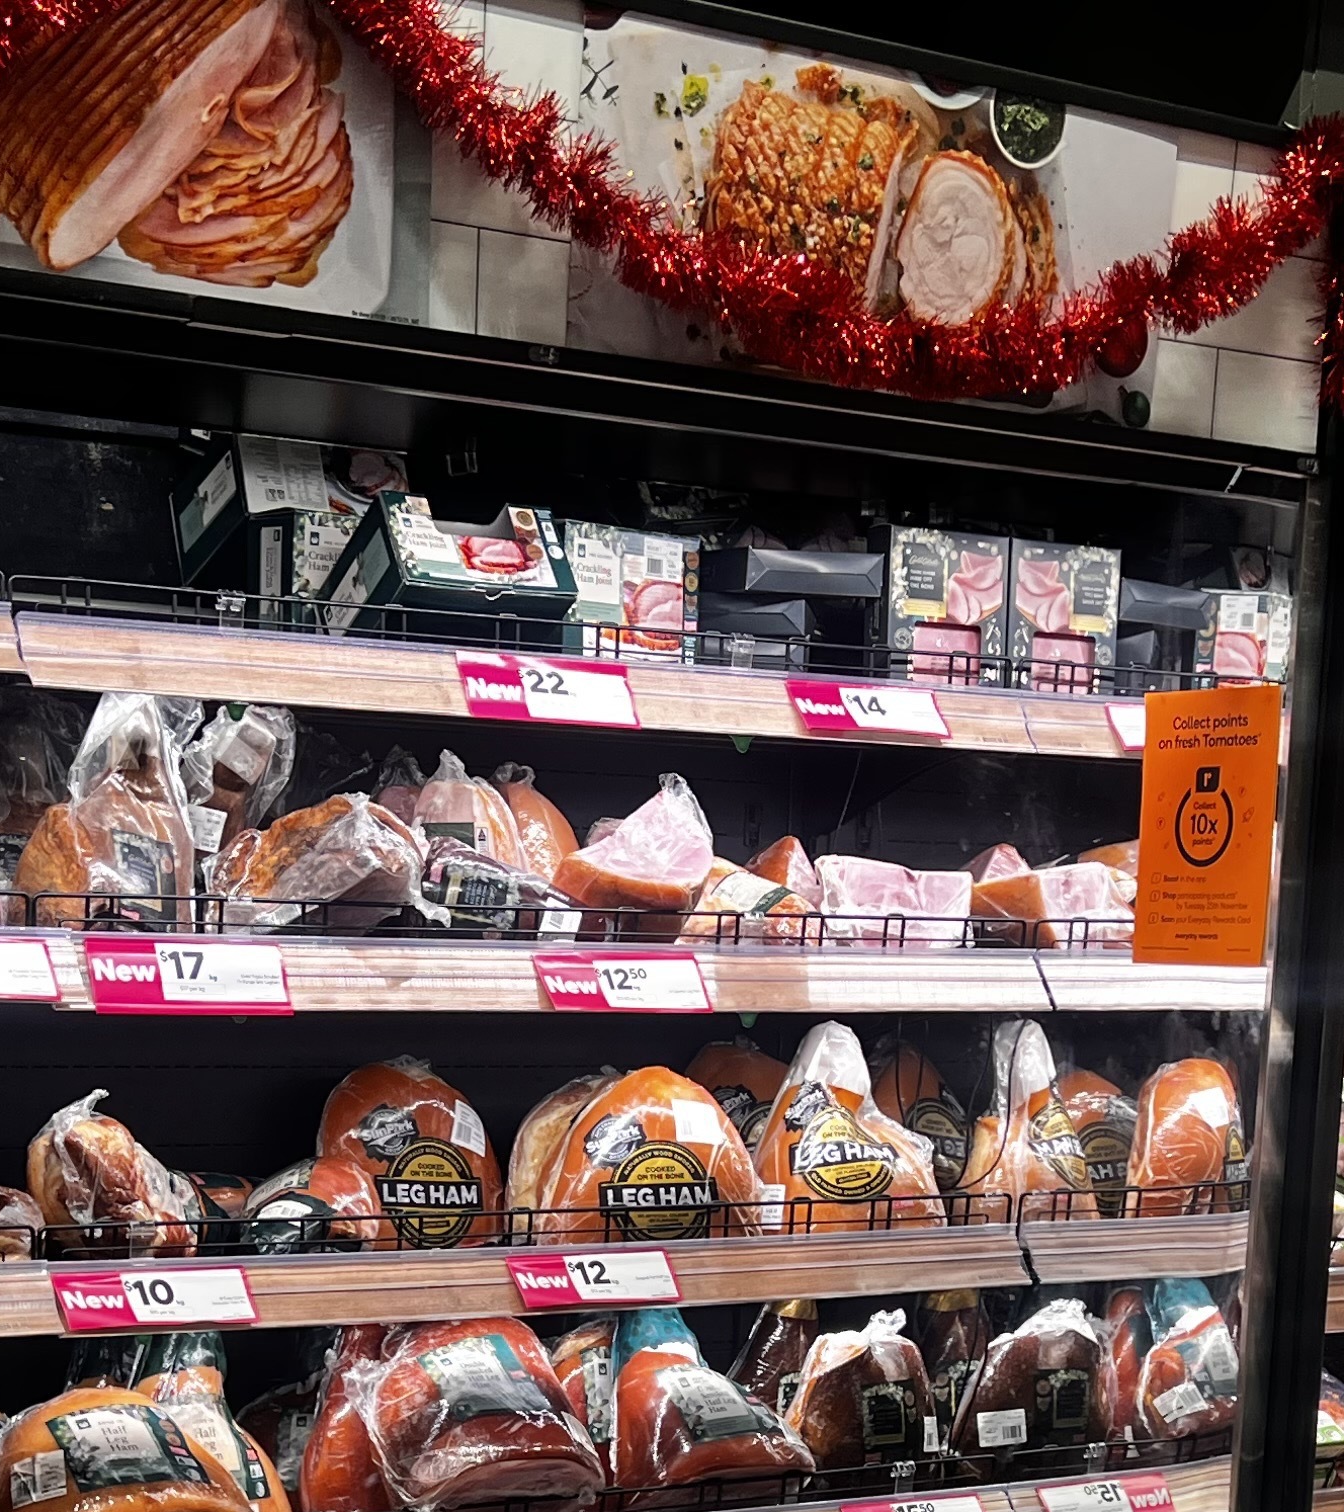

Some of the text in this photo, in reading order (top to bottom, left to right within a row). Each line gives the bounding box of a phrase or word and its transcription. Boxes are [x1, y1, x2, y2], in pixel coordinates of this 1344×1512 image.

[308, 562, 330, 571] Ham
[577, 563, 612, 577] Crackling
[466, 676, 521, 701] New
[517, 669, 569, 695] $22
[795, 697, 846, 716] New
[1173, 713, 1249, 732] Collect points
[1158, 734, 1200, 749] on fresh
[1193, 801, 1216, 810] Collect
[1190, 813, 1218, 835] 10x
[91, 957, 156, 982] New
[160, 951, 204, 980] $17
[543, 974, 598, 994] New
[844, 1141, 894, 1160] HAM
[382, 1183, 478, 1205] LEG HAM
[606, 1186, 711, 1207] LEG HAM
[516, 1273, 569, 1289] New
[568, 1261, 611, 1285] $12
[61, 1290, 123, 1310] New
[125, 1279, 174, 1306] $10
